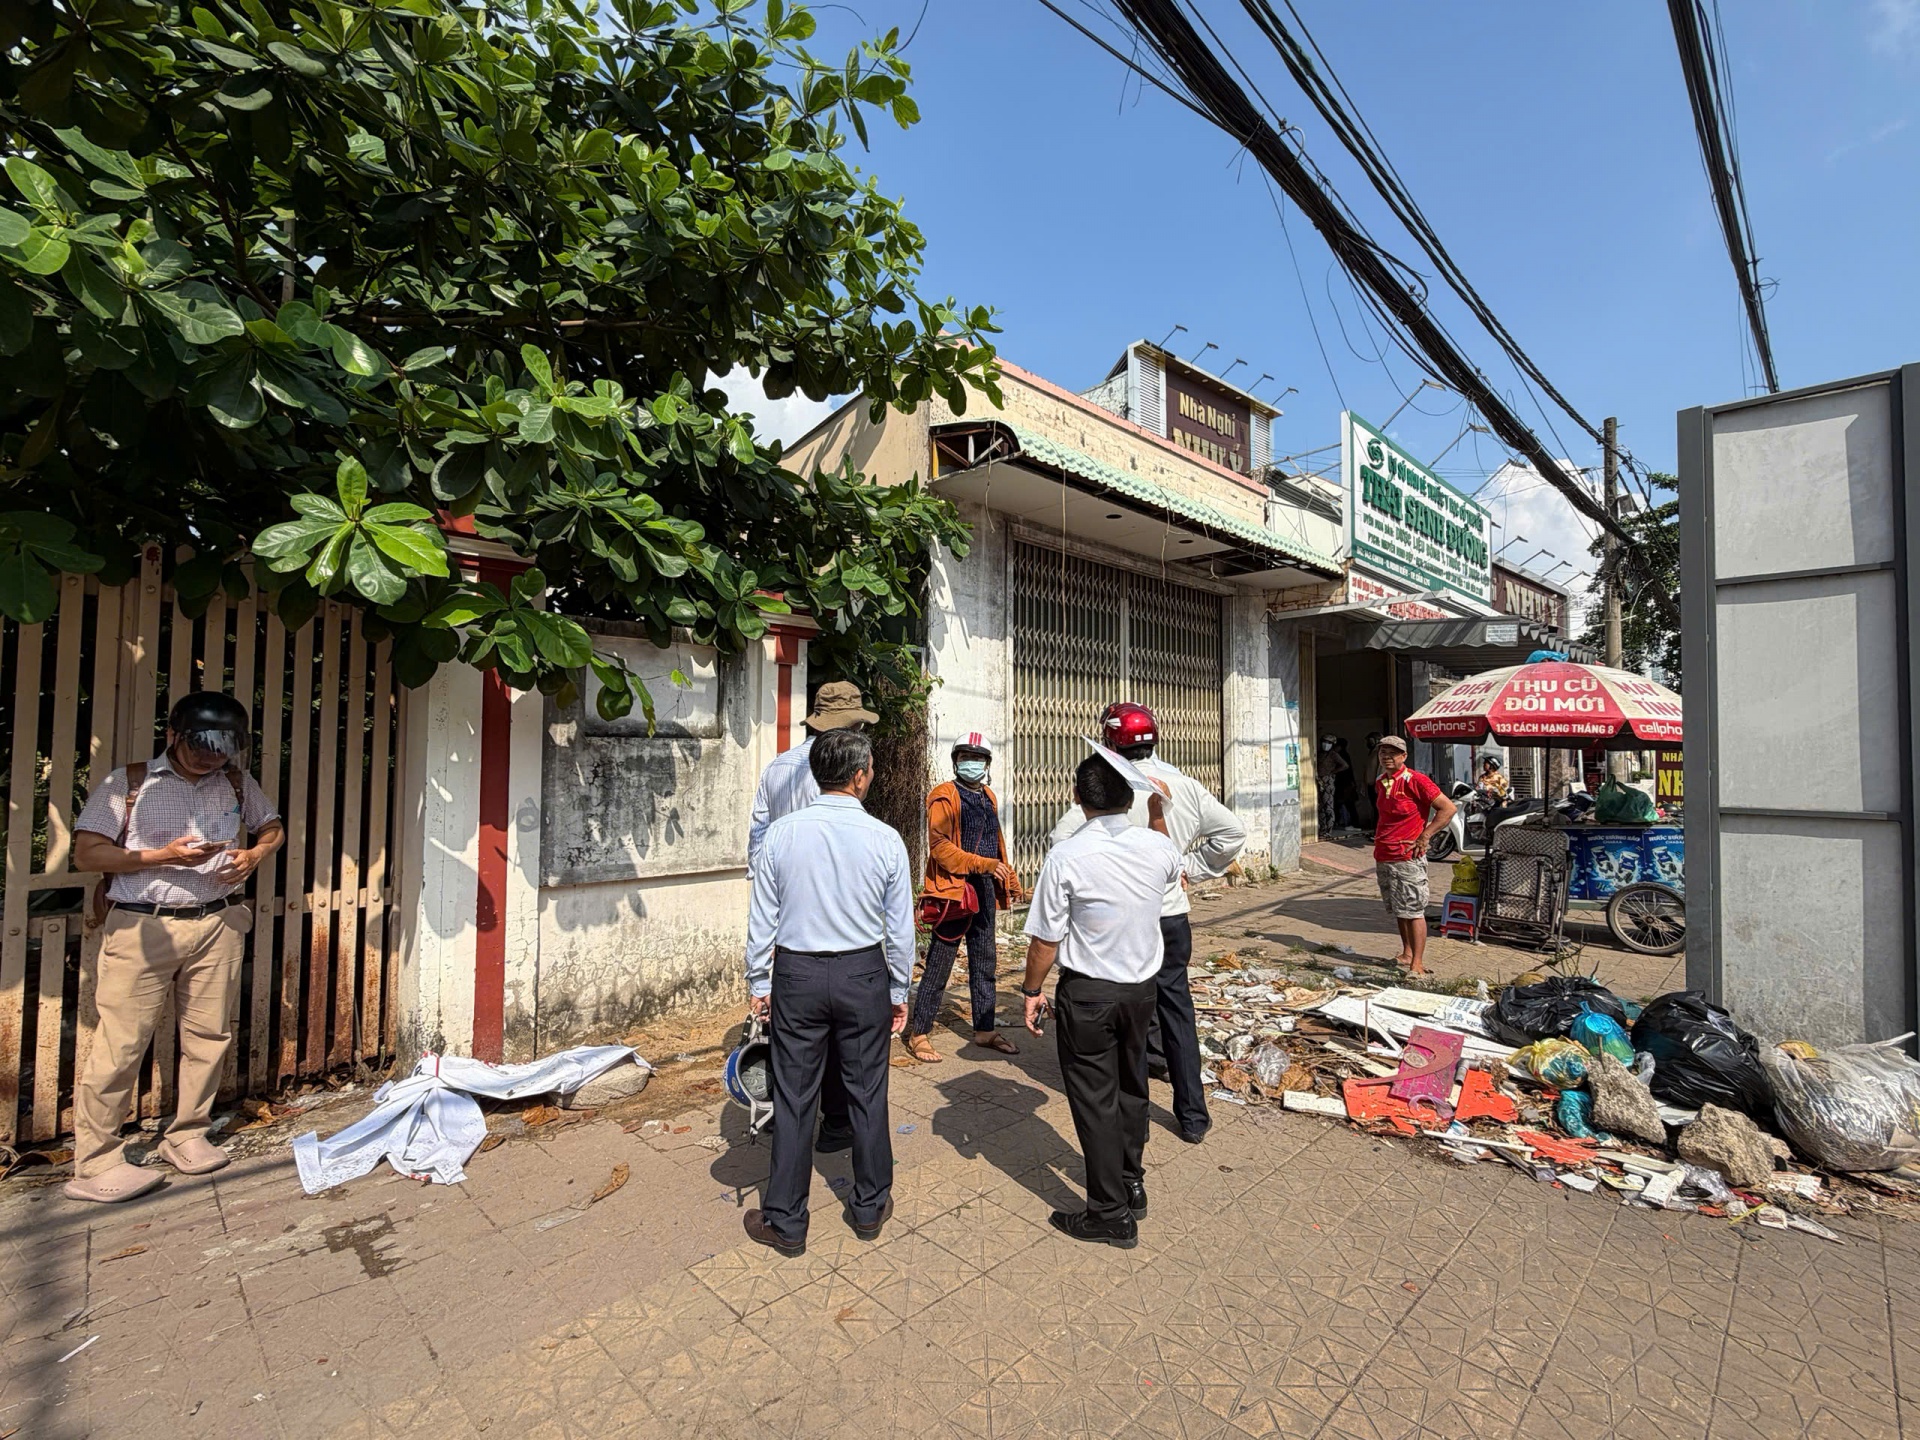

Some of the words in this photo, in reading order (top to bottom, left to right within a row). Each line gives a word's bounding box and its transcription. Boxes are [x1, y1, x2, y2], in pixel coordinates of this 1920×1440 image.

[1179, 392, 1206, 425] Nhà
[1207, 405, 1236, 439] Nghỉ
[1404, 494, 1446, 547] SANH
[1452, 680, 1499, 698] ĐIỆN
[1510, 679, 1558, 693] THU
[1564, 676, 1599, 693] CŨ
[1612, 680, 1660, 697] MÁY
[1429, 698, 1484, 715] THOẠI
[1504, 692, 1546, 712] ĐỔI
[1553, 693, 1606, 712] MỚI
[1632, 697, 1682, 716] TÍNH
[1495, 723, 1511, 732] 133
[1513, 722, 1538, 732] CÁCH
[1541, 723, 1569, 734] MẠNG
[1572, 722, 1606, 734] THÁNG
[1607, 724, 1614, 734] 8
[1662, 750, 1683, 762] NHÀ
